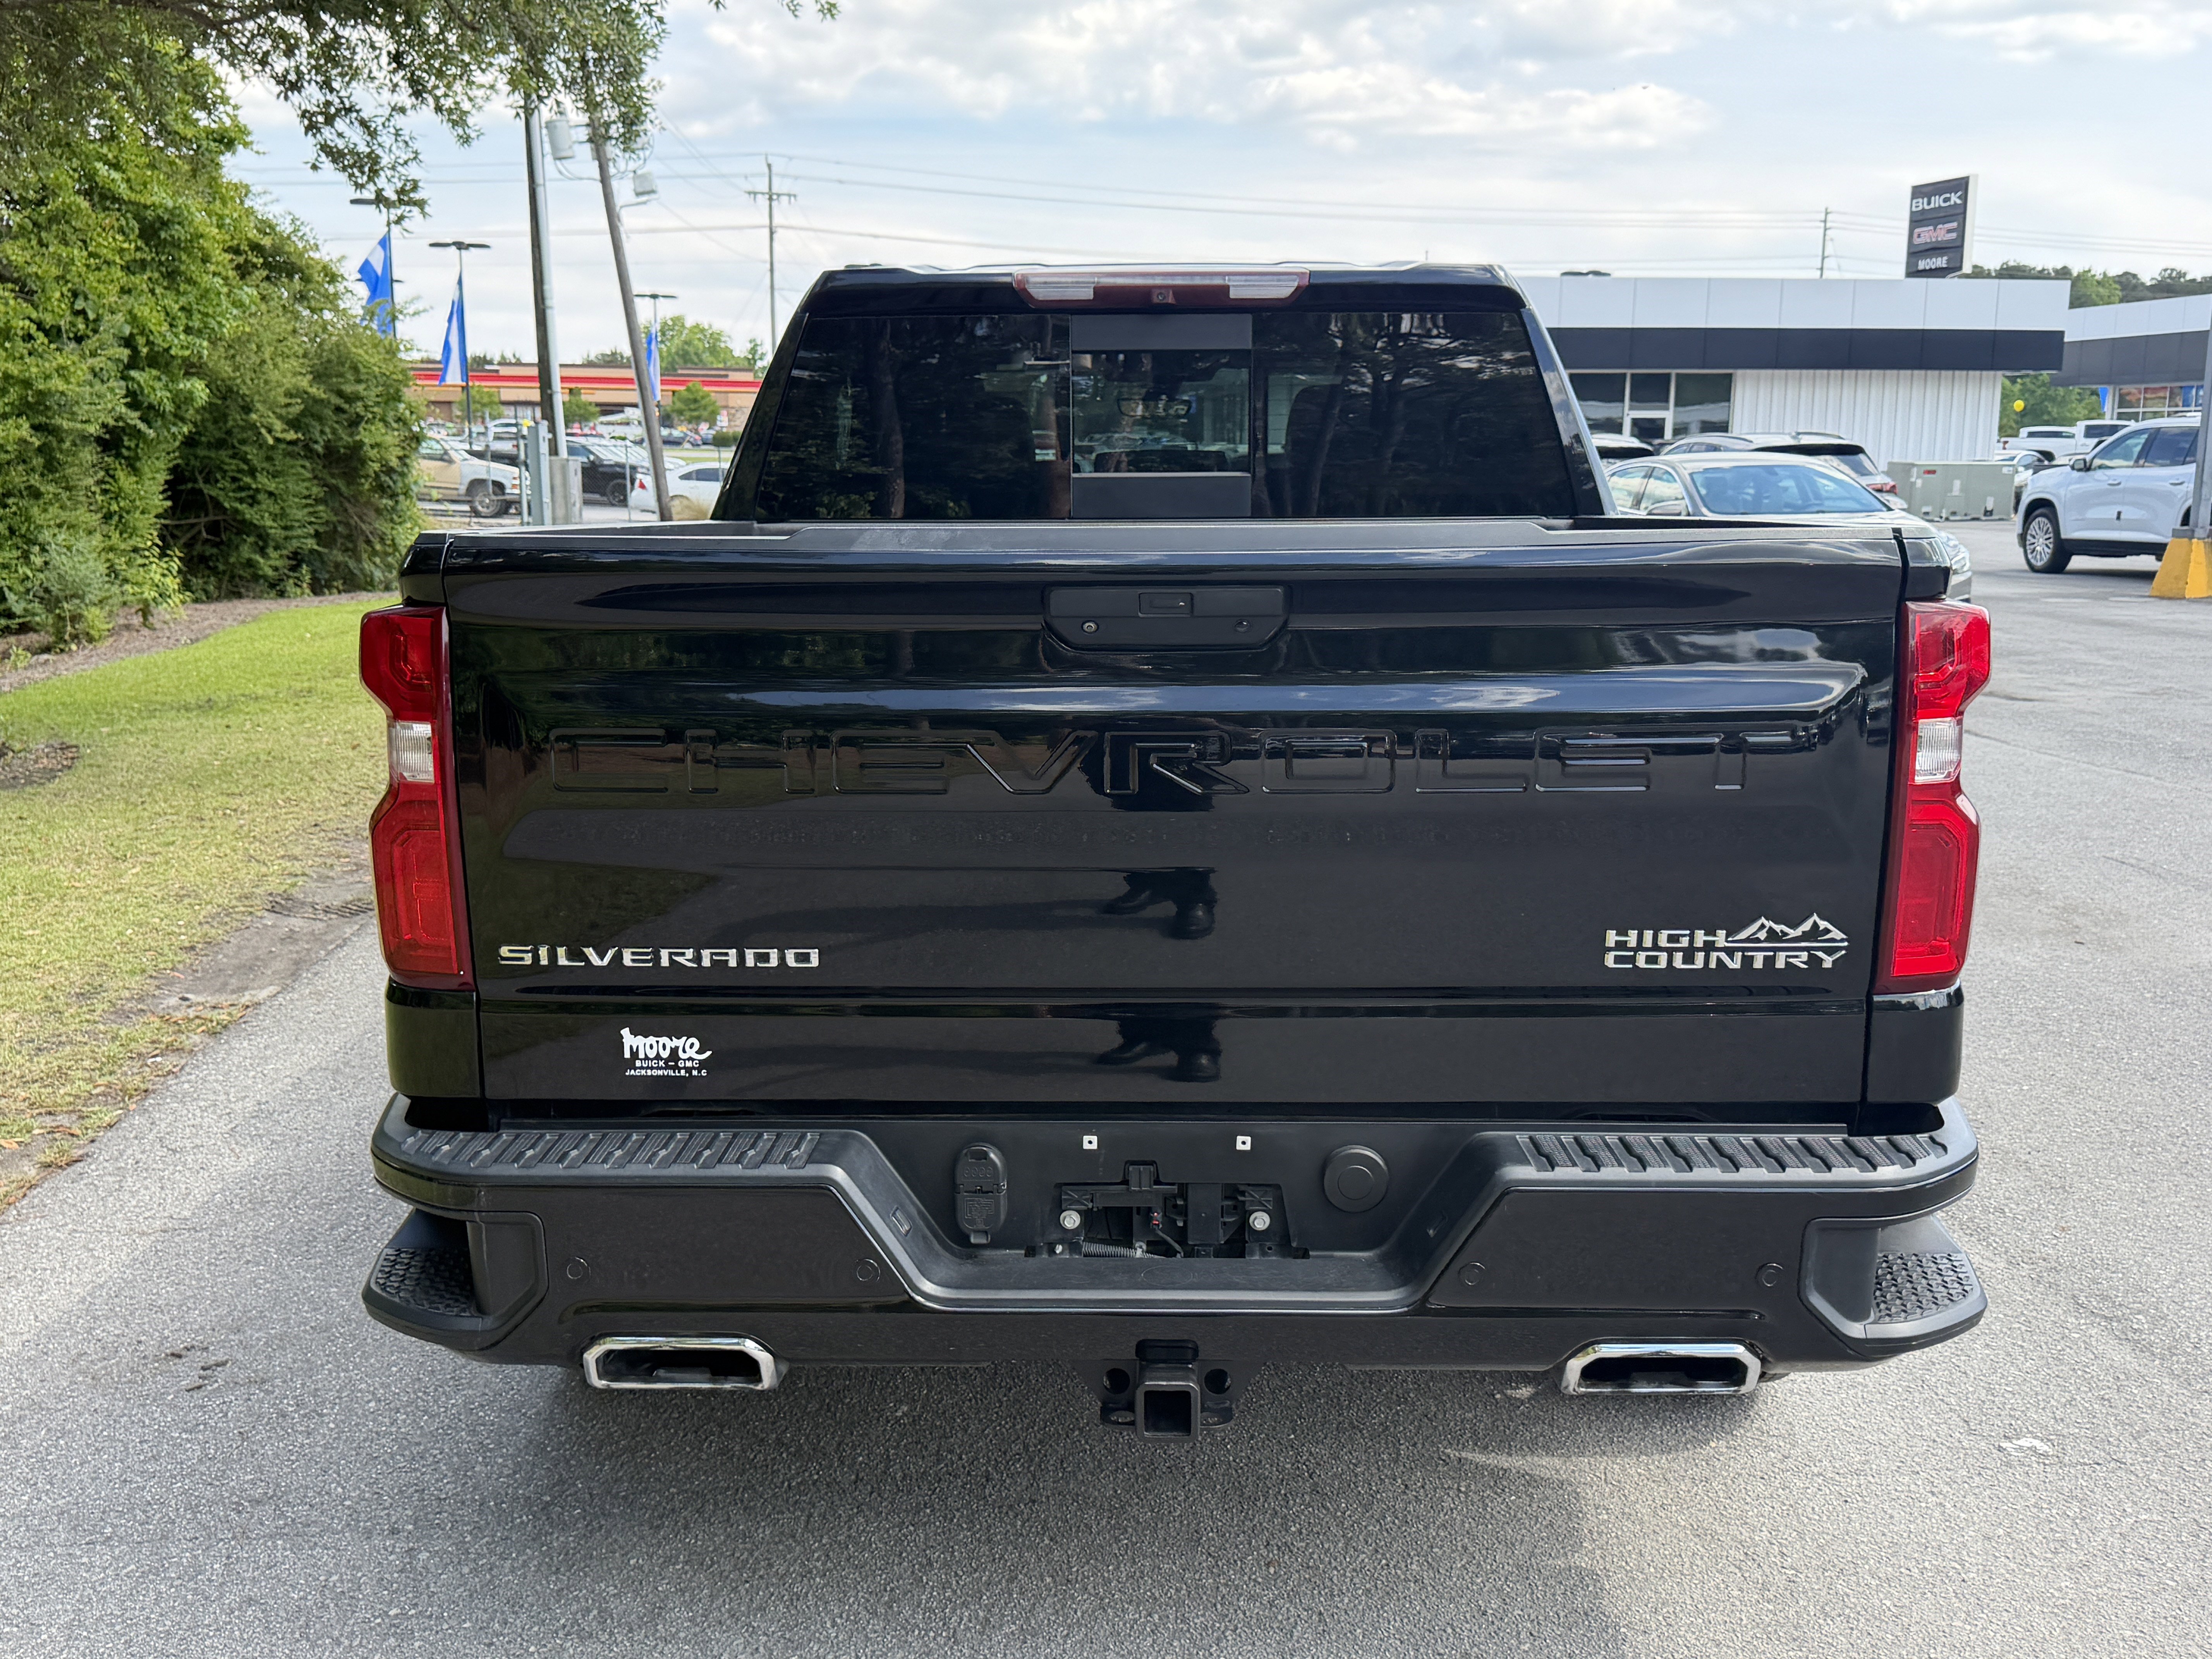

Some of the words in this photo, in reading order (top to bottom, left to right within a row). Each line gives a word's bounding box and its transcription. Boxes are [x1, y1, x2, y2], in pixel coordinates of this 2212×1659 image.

[1911, 191, 1963, 211] BUICK
[1913, 222, 1958, 244] GMC
[1918, 256, 1948, 270] MOORE
[548, 723, 1805, 796] CHEVROLET
[1604, 929, 1726, 948] HIGH
[498, 944, 819, 968] SILVERADO
[1604, 950, 1847, 969] COUNTRY
[625, 1069, 689, 1077] JACKSONVILLE,
